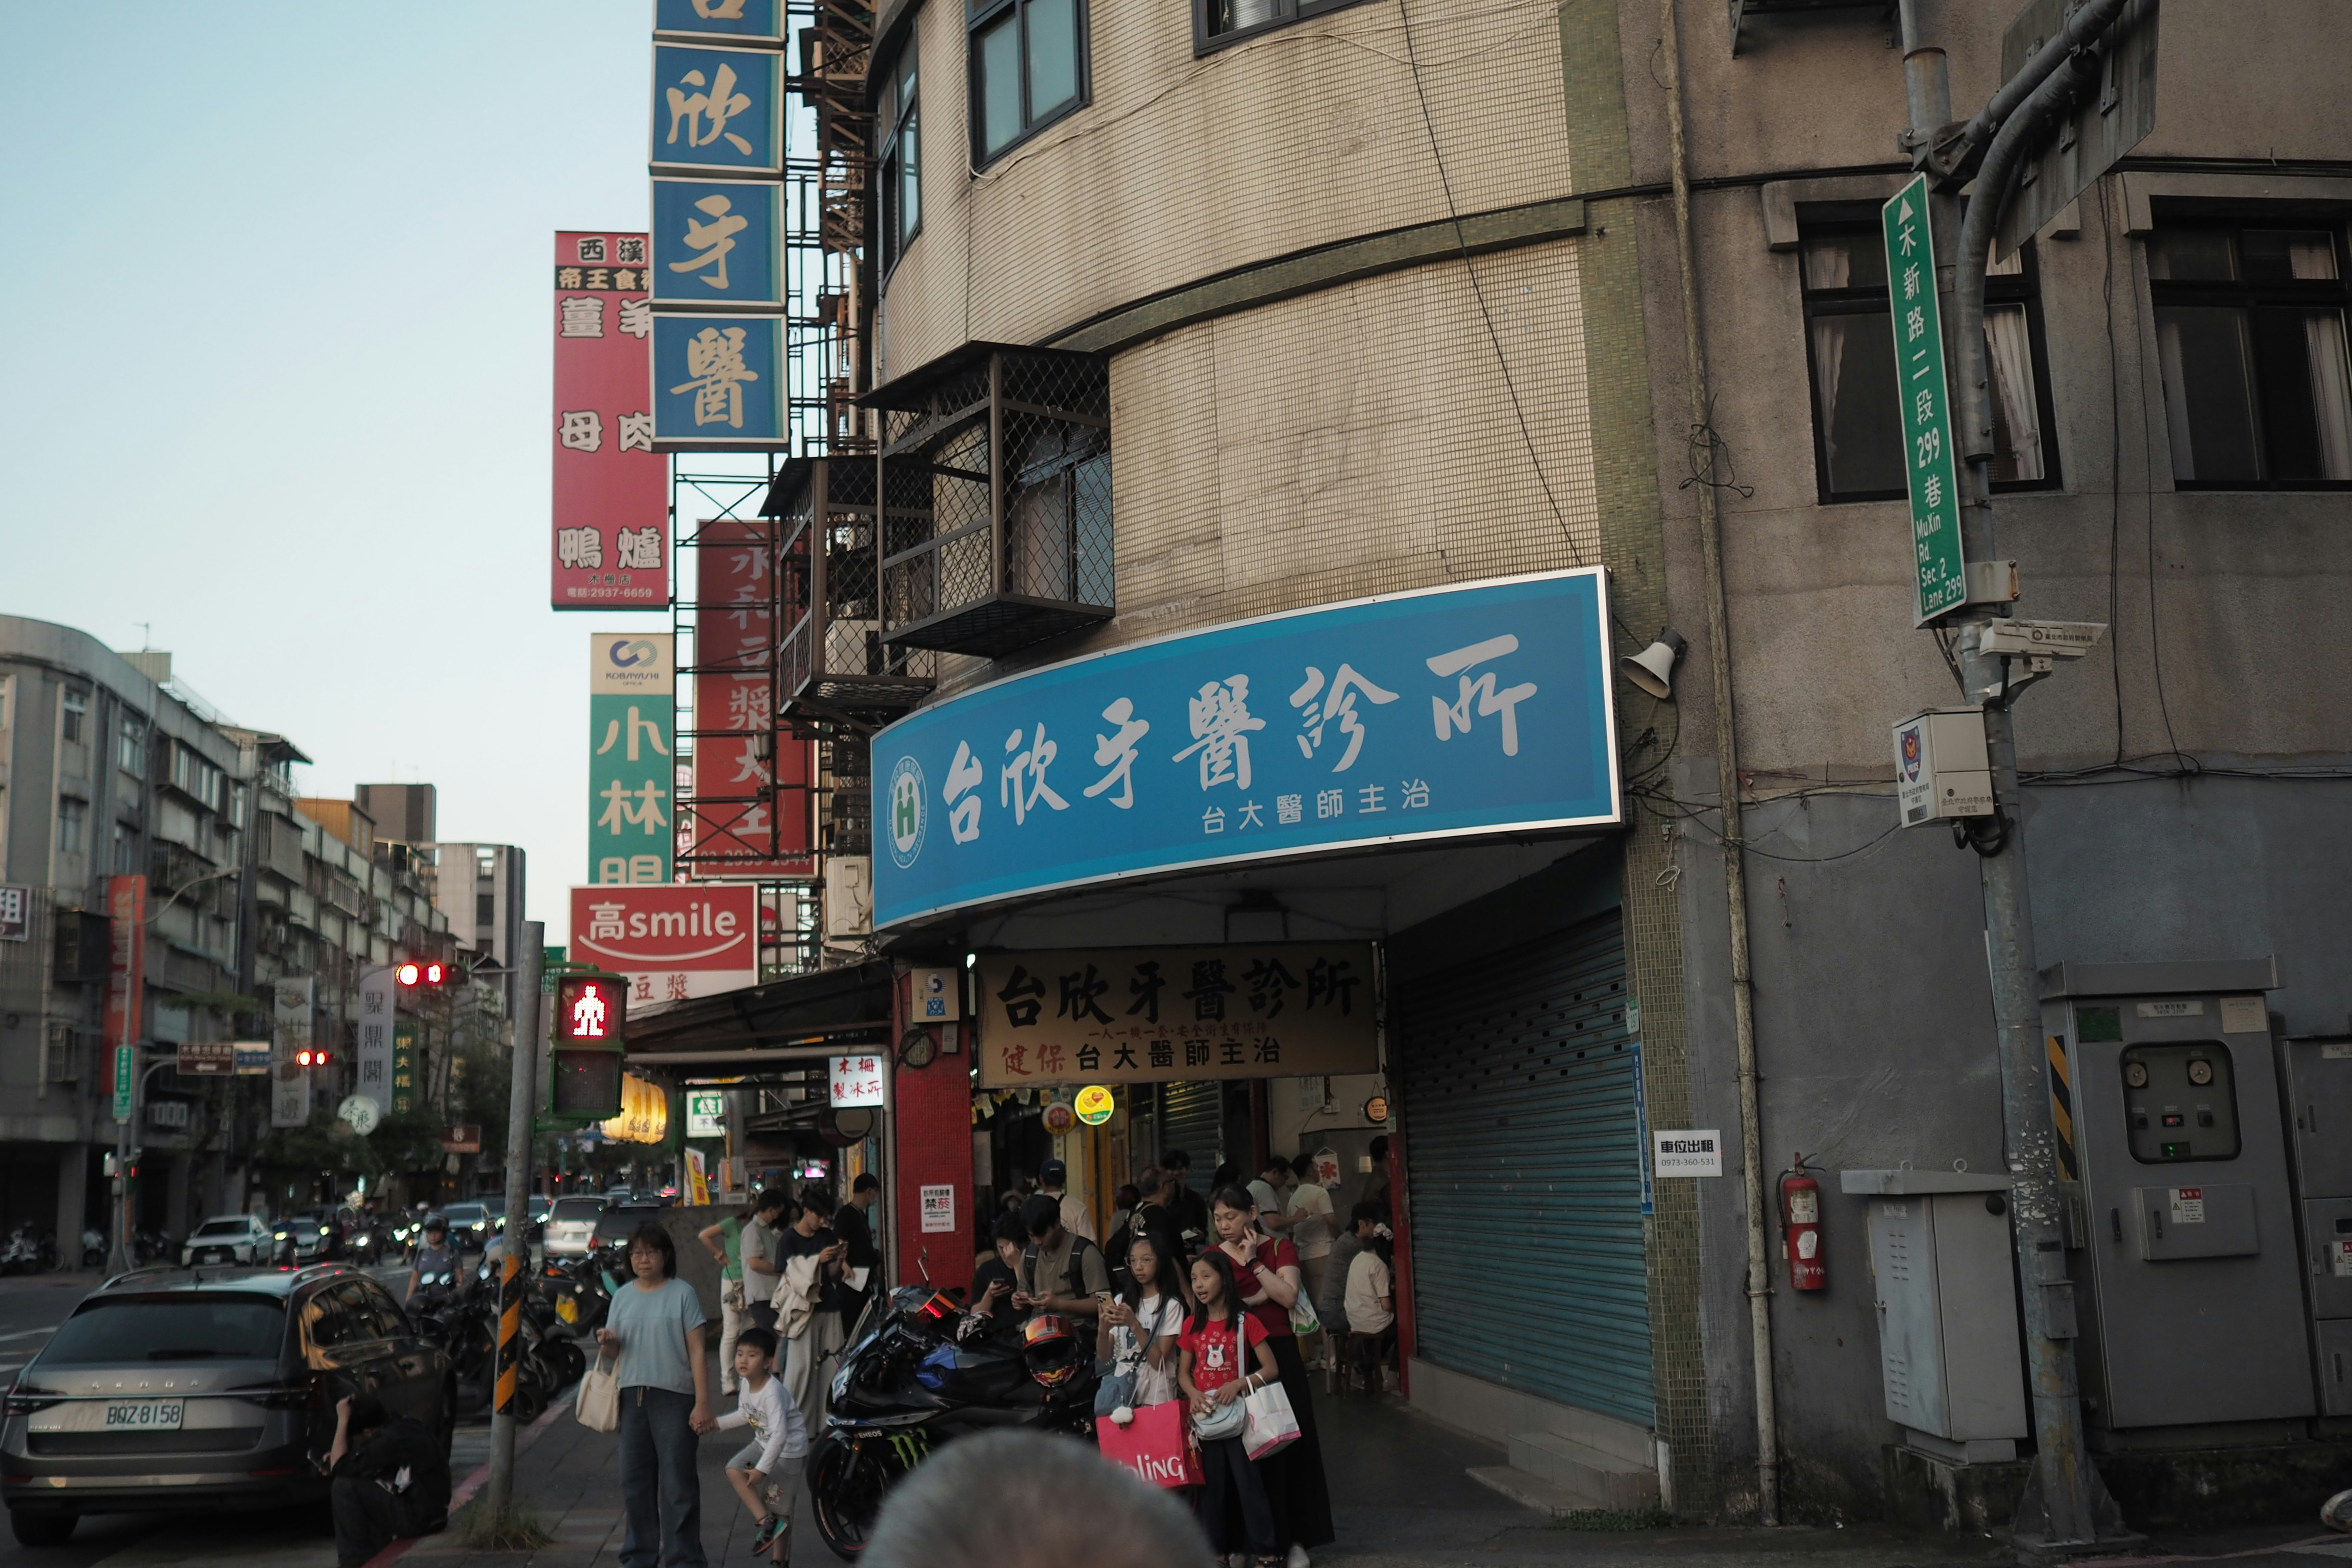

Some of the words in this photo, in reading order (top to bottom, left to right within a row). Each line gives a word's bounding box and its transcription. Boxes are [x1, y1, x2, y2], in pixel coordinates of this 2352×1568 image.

[1899, 224, 1941, 509] 木新路二段299巷
[1917, 512, 1941, 540] MuXin
[1919, 541, 1931, 564] Rd.
[588, 574, 631, 585] 木柵店
[1921, 567, 1939, 587] Sec.
[1940, 557, 1947, 579] 2
[1923, 589, 1943, 611] Lane
[1945, 575, 1962, 601] 299
[942, 634, 1538, 845] 台欣牙醫診所
[1202, 778, 1430, 834] 台大醫師主治
[634, 974, 691, 1001] 豆漿
[997, 955, 1360, 1029] 台欣牙醫診所
[839, 1057, 875, 1075] 木柵
[1001, 1043, 1066, 1075] 健保
[1075, 1036, 1281, 1071] 台大醫師主治
[832, 1080, 884, 1100] 製冰所
[1660, 1139, 1714, 1154] 車位出租
[1661, 1158, 1715, 1167] 0973-360-531
[924, 1197, 950, 1212] 禁菸
[857, 1430, 883, 1439] ENEOS
